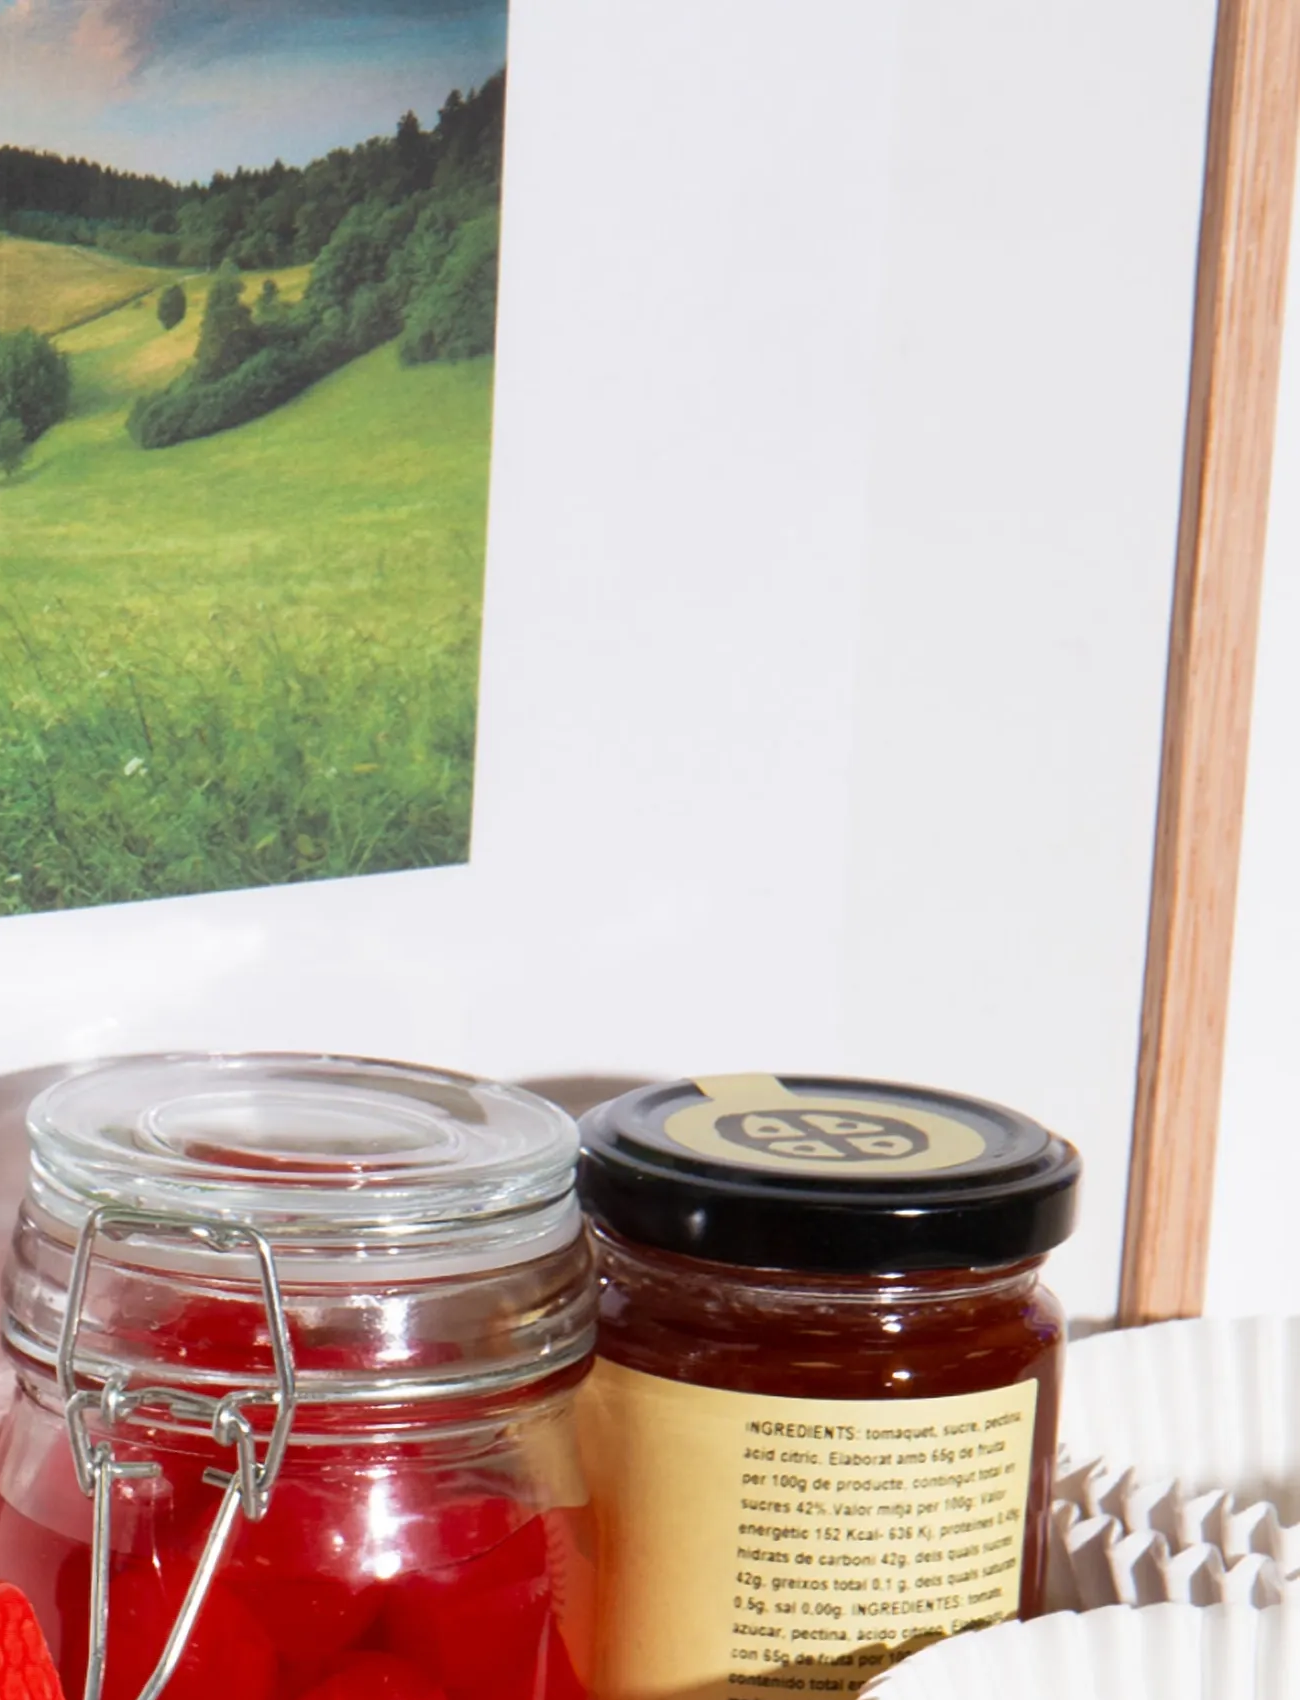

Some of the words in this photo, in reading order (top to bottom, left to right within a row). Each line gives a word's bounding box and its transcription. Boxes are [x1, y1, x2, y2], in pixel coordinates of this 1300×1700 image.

[745, 1420, 860, 1441] INGREDIENTS:
[896, 1451, 927, 1465] amb
[959, 1447, 973, 1460] de
[742, 1473, 767, 1487] per
[771, 1474, 807, 1493] 100g
[813, 1477, 831, 1490] de
[741, 1498, 791, 1514] sucres
[917, 1502, 940, 1516] per
[814, 1526, 841, 1541] 152
[737, 1546, 789, 1564] hidrats
[795, 1551, 814, 1565] de
[819, 1552, 877, 1567] carboni
[771, 1577, 829, 1591] greixos
[833, 1577, 867, 1591] total
[775, 1601, 796, 1614] sal
[731, 1648, 758, 1661] con
[796, 1652, 814, 1666] de
[857, 1653, 885, 1668] por
[728, 1672, 805, 1691] contenido
[809, 1678, 845, 1691] total
